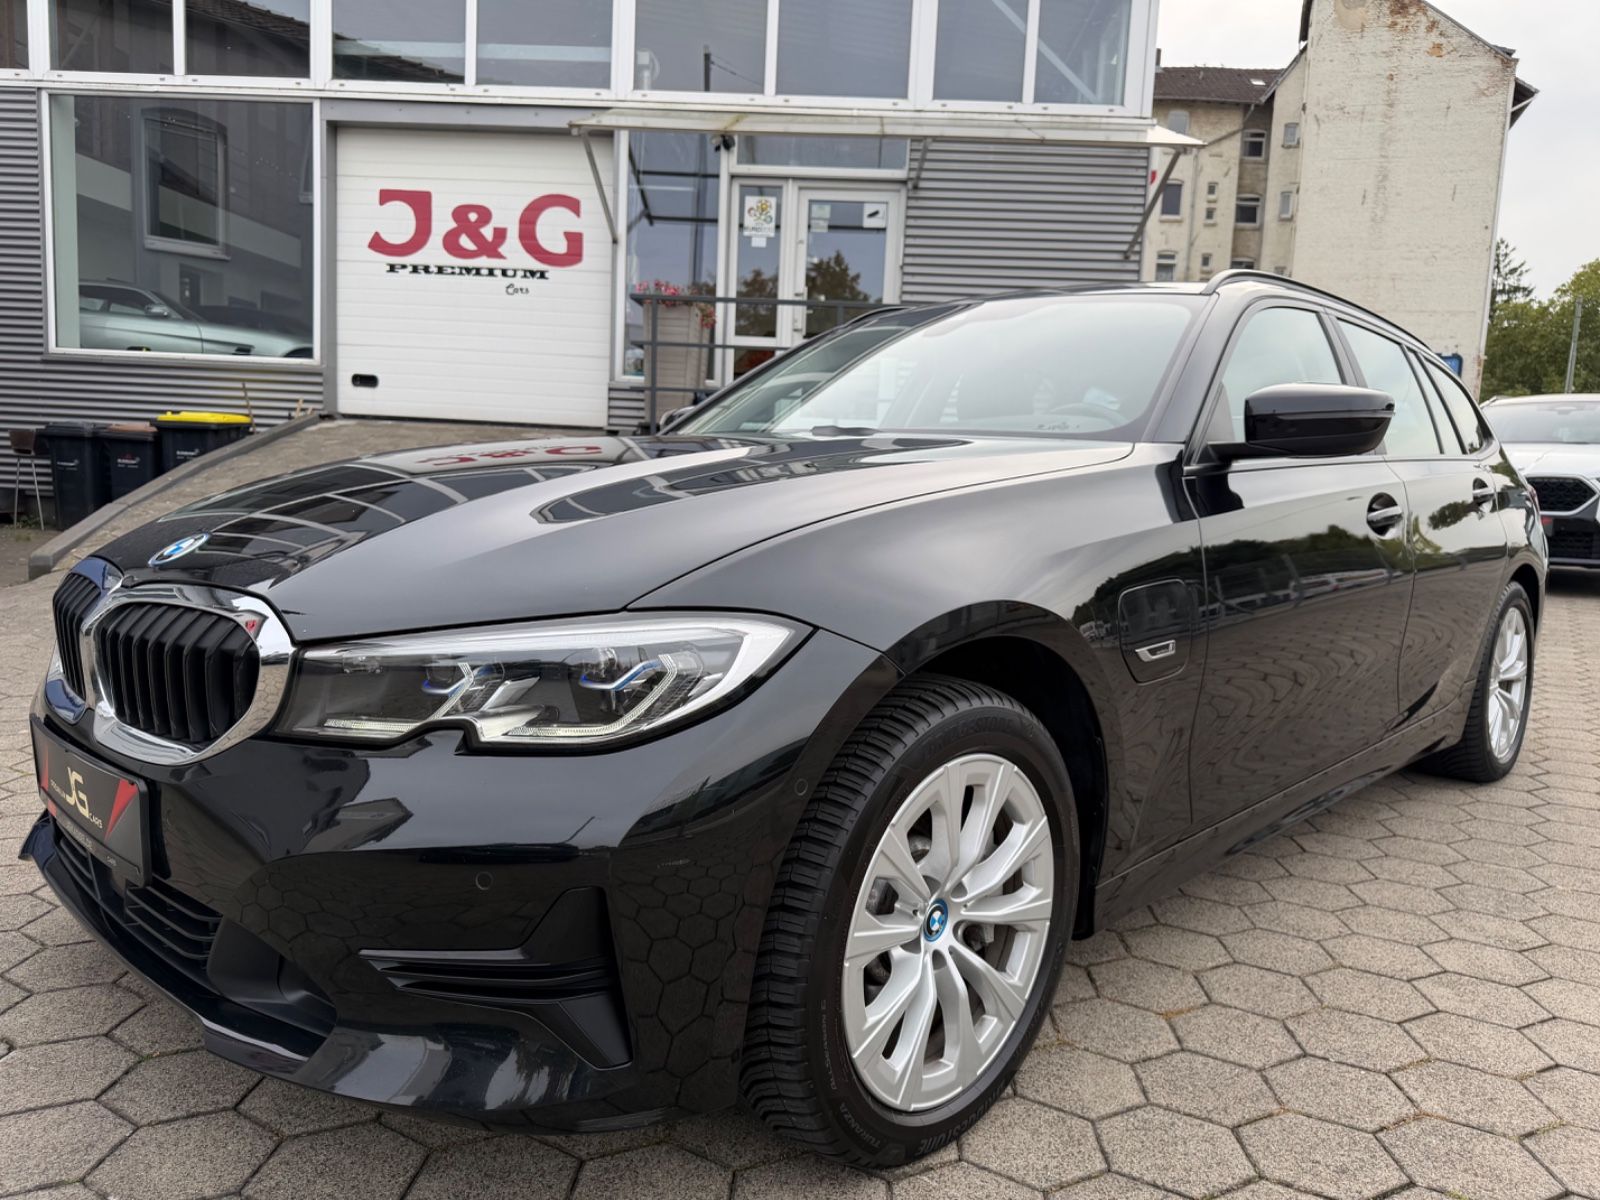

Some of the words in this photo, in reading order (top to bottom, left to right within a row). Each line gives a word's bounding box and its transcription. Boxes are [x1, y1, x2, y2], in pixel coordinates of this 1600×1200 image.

[367, 188, 584, 268] J&G
[386, 262, 550, 280] PREMIUM
[505, 283, 530, 296] Cars
[839, 1102, 881, 1148] TURANZA
